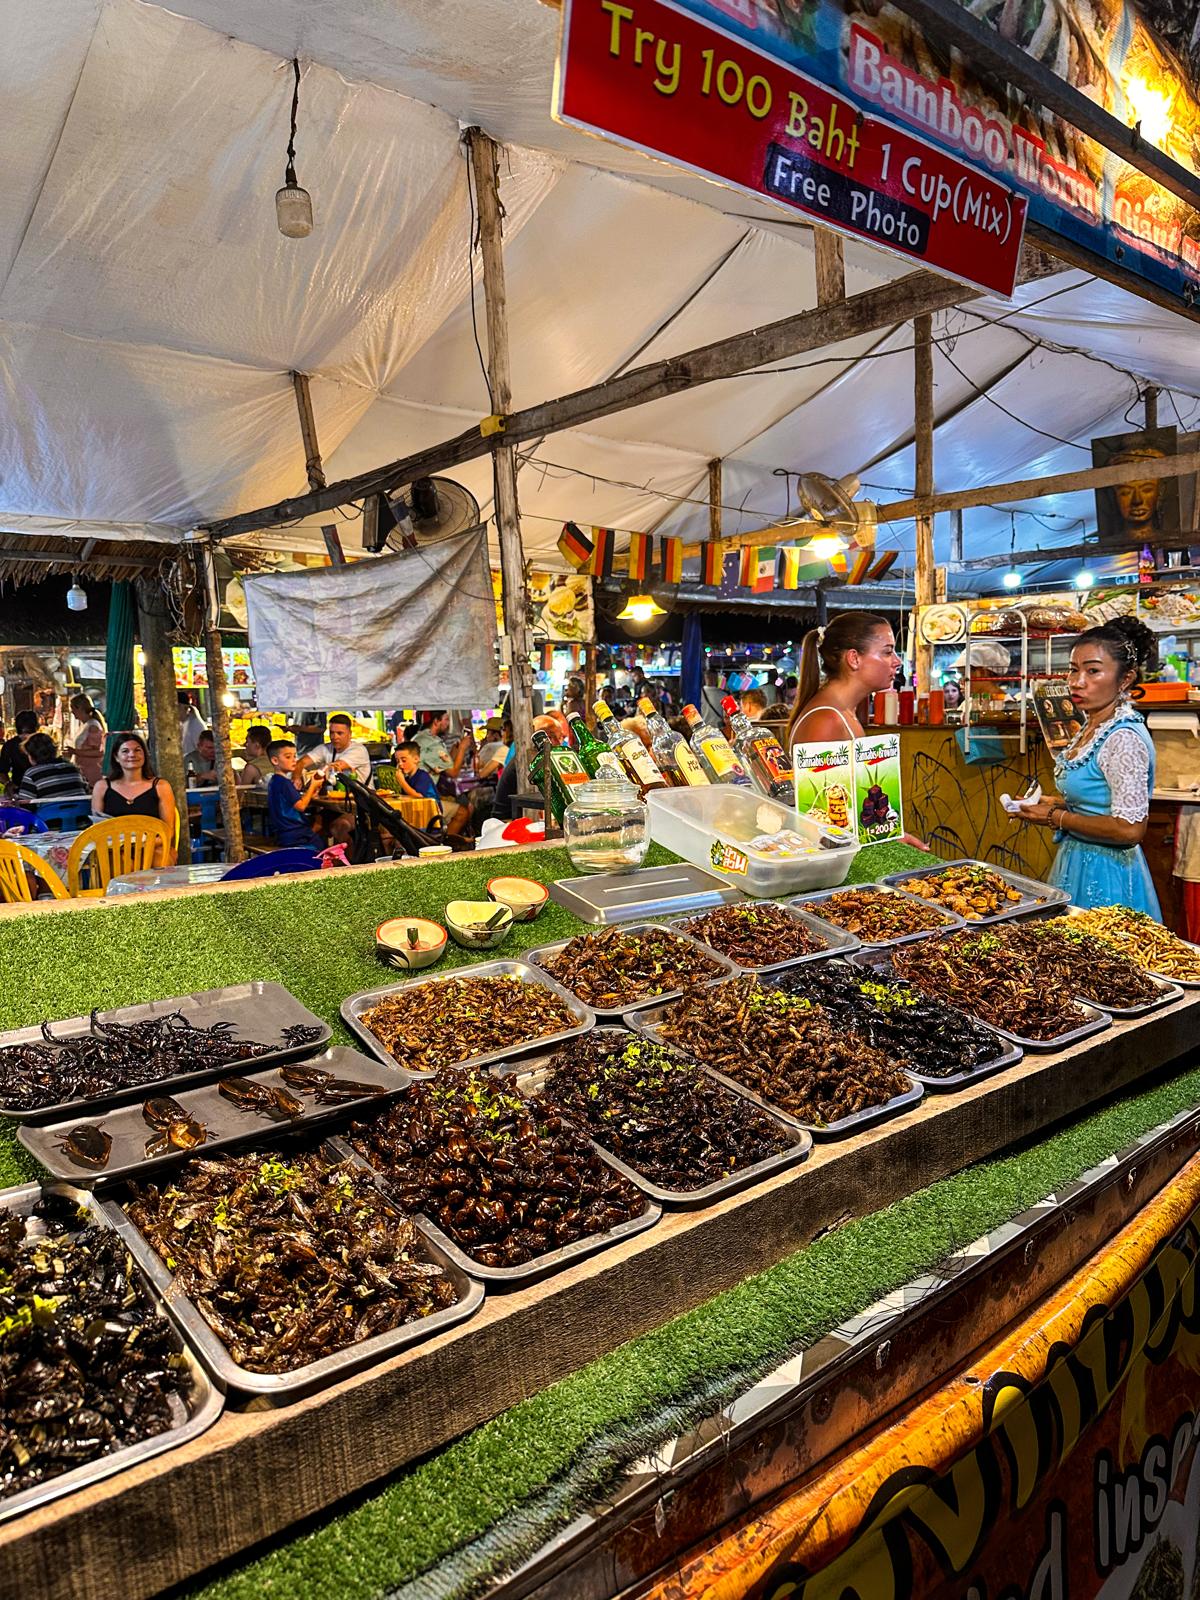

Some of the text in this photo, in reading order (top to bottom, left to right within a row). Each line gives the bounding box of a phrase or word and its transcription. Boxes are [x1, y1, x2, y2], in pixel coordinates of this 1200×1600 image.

[602, 1, 681, 94] Try
[702, 50, 772, 118] 100
[785, 91, 860, 168] Baht
[881, 143, 891, 181] 1
[852, 33, 1096, 216] Bamboo Worm
[773, 154, 920, 246] Free Photo
